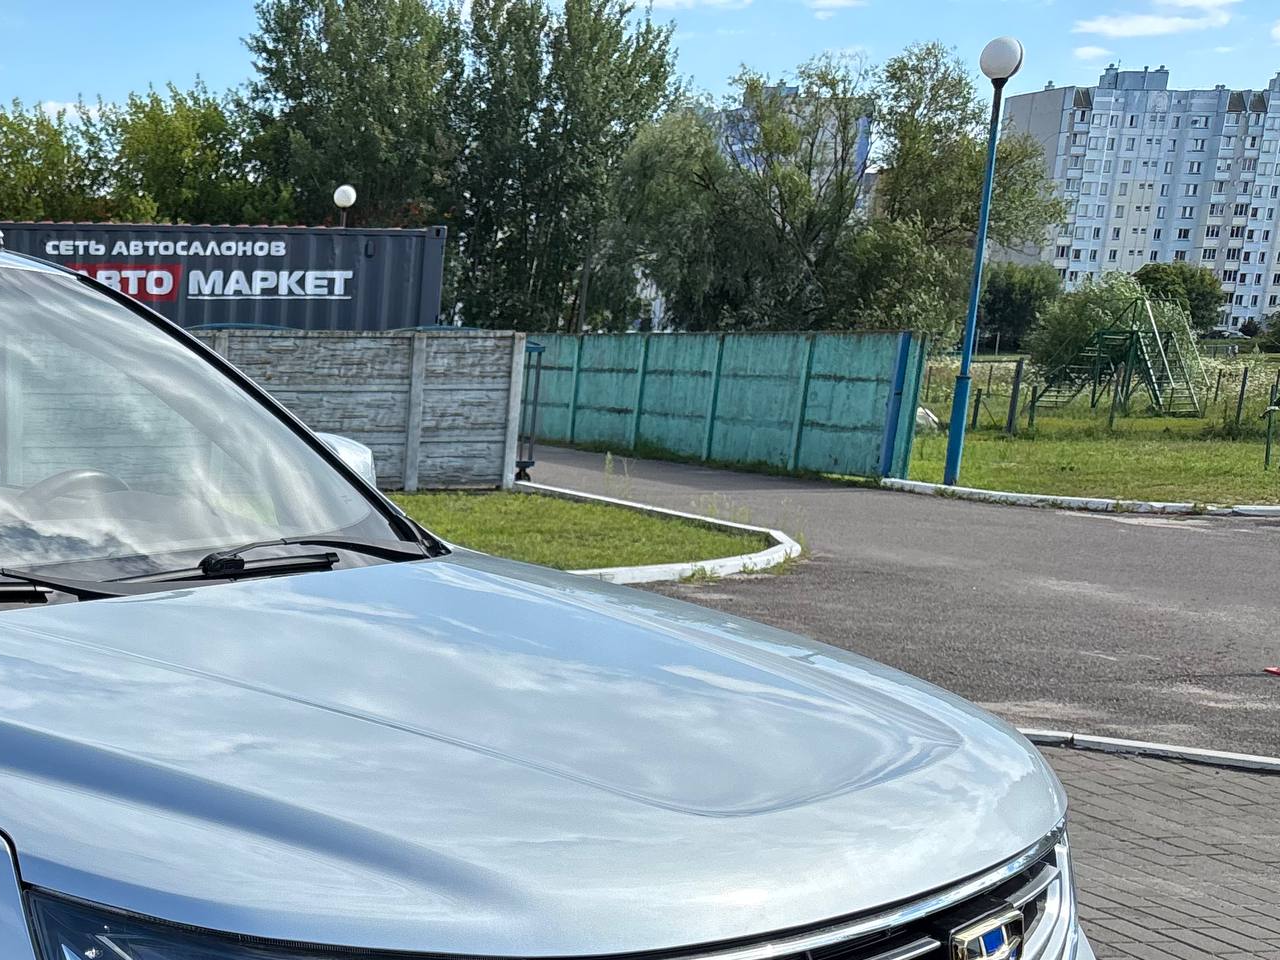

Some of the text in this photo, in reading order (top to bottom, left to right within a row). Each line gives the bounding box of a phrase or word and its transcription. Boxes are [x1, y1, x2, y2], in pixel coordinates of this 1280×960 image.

[45, 240, 287, 257] СЕТЬ АВТОСАЛОНОВ
[77, 269, 353, 296] ВТО МАРКЕТ
